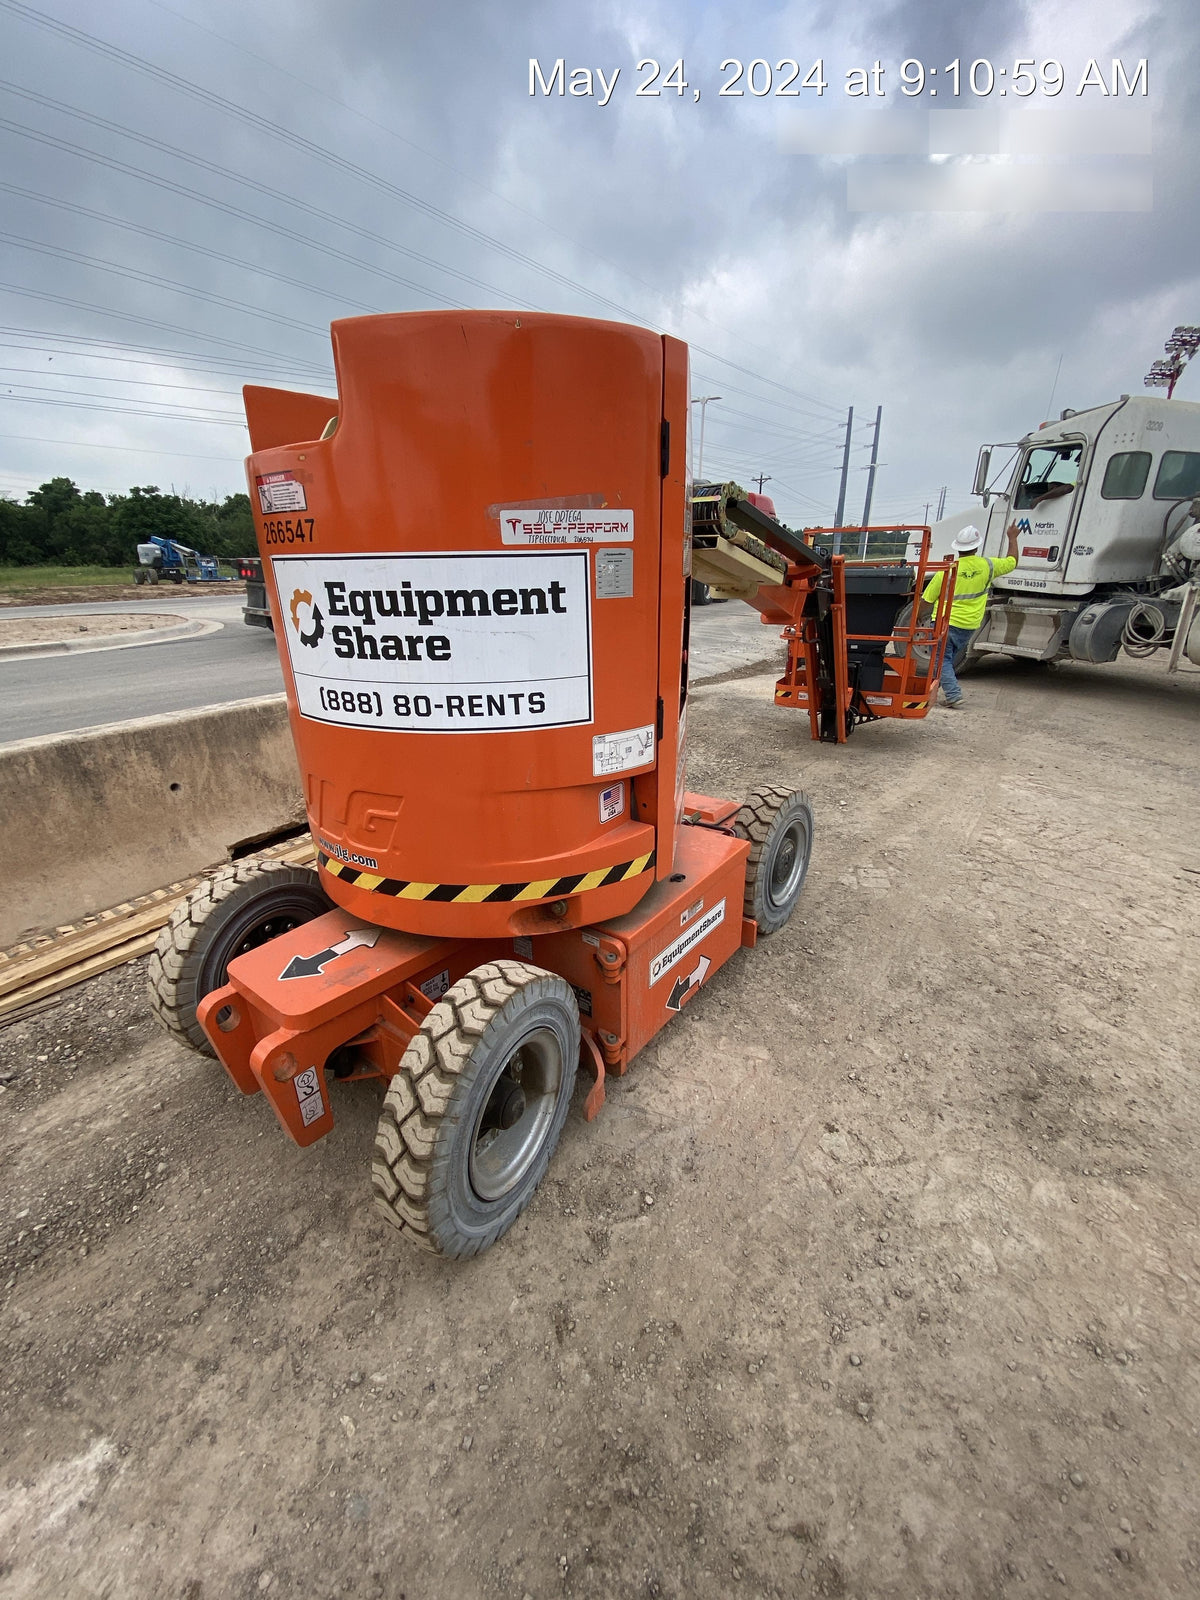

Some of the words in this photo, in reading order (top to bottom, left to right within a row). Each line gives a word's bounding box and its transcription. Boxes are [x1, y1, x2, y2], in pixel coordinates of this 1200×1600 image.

[522, 522, 629, 535] SELF-PERFORM
[536, 510, 553, 524] JOSE
[555, 509, 582, 524] ORTEGA
[1034, 521, 1055, 529] Martin
[264, 518, 314, 545] 266547
[324, 580, 567, 626] Equipment
[331, 625, 452, 662] Share
[319, 686, 383, 717] (888)
[394, 691, 546, 718] 80-RENTS
[607, 808, 617, 817] USA
[319, 837, 379, 870] www.jlg.com
[661, 909, 722, 968] EquipmentShare
